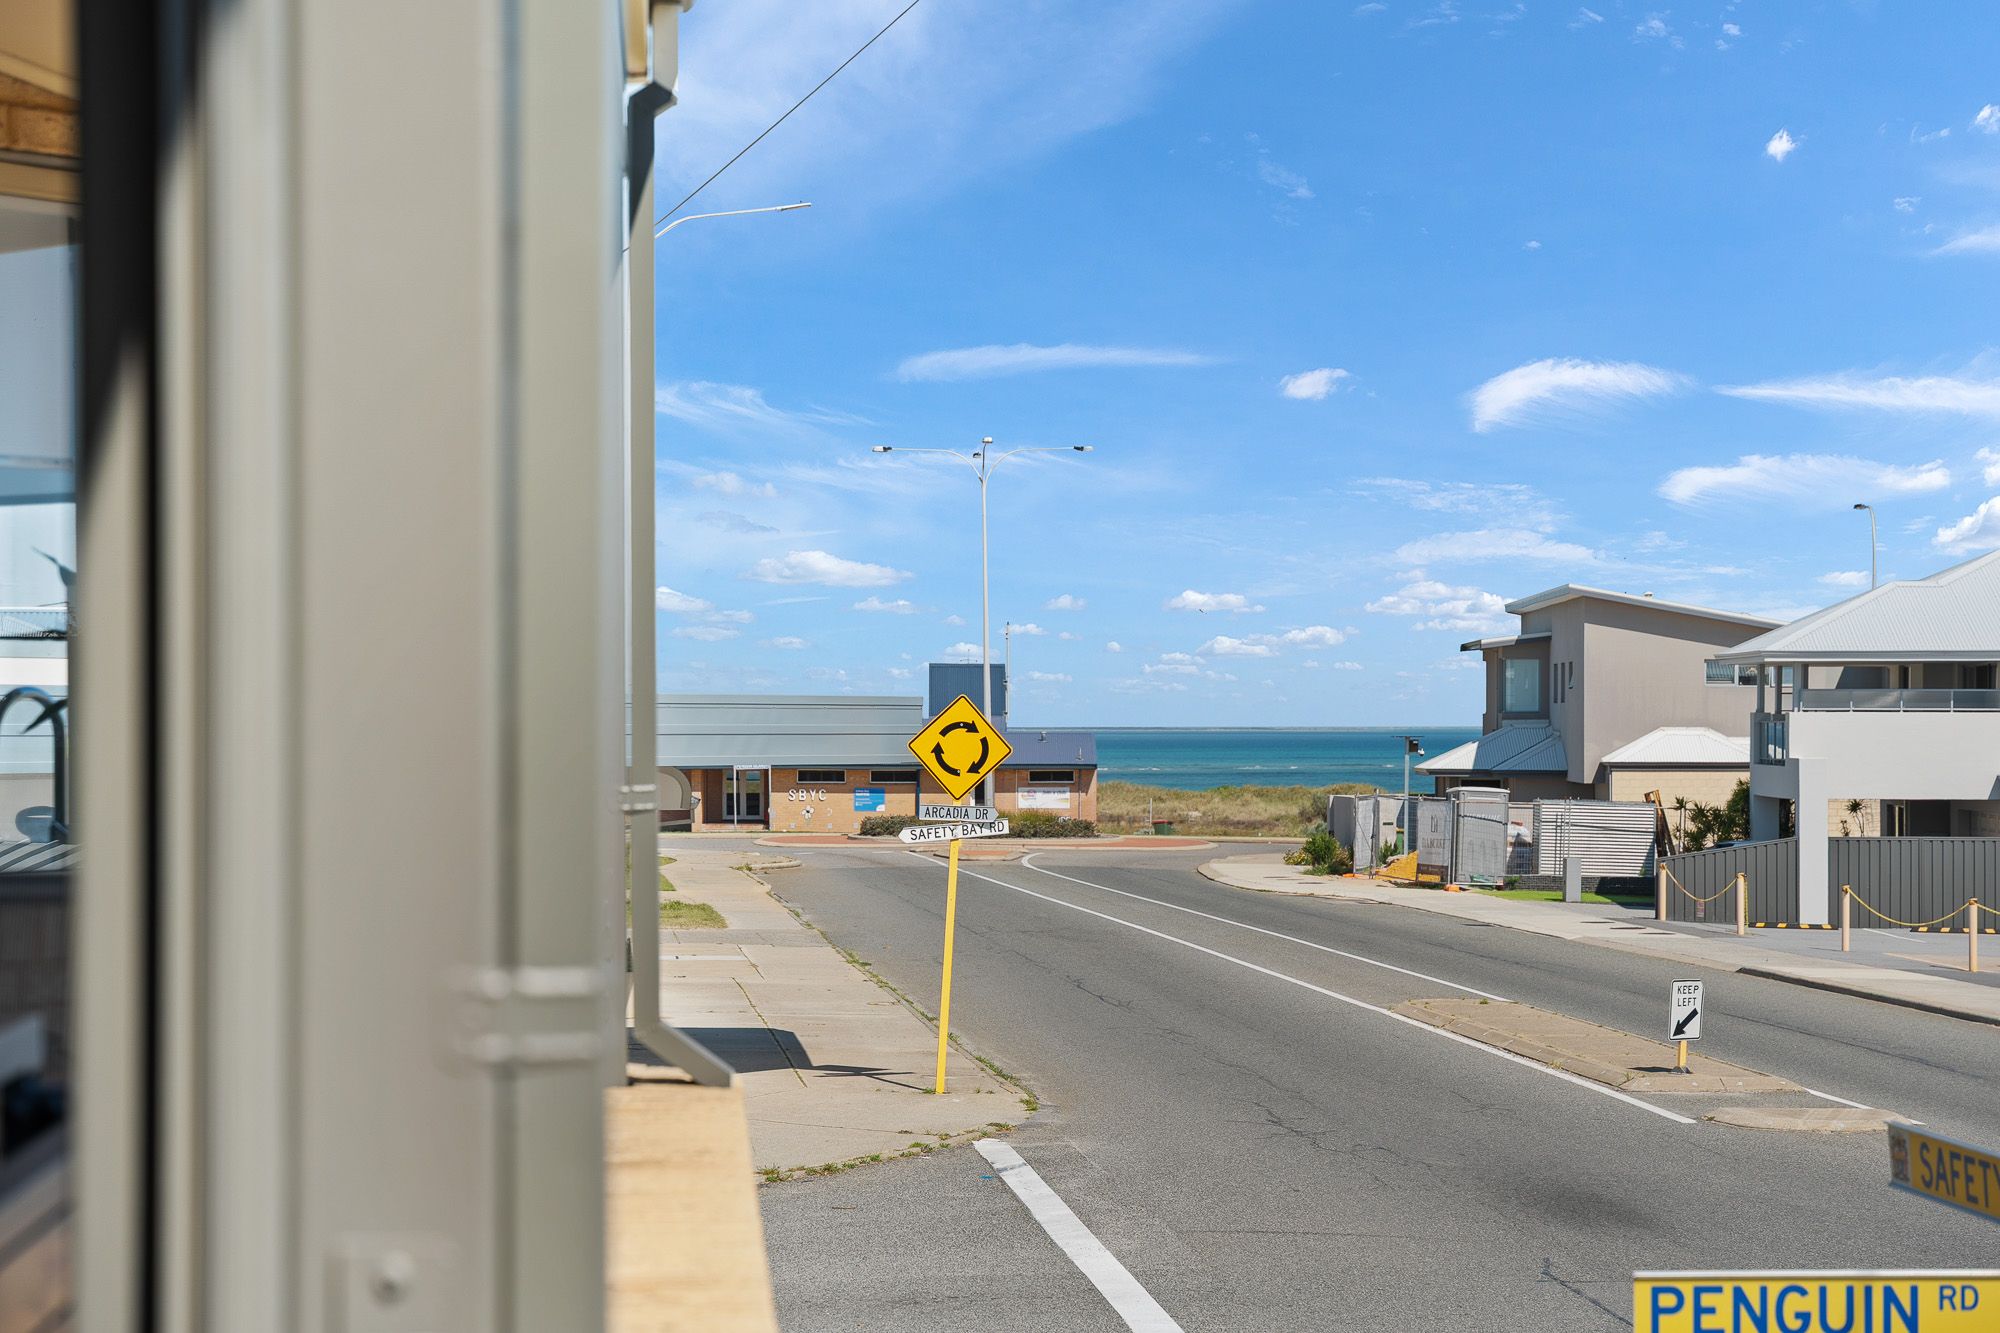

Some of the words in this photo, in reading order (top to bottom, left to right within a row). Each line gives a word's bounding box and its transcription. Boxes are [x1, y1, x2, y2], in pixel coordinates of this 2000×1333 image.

[788, 789, 827, 801] SBYC
[924, 806, 969, 819] ARCADIA
[975, 809, 988, 819] DR
[910, 826, 955, 840] SAFETY
[961, 823, 984, 835] BAY
[990, 821, 1004, 832] RD
[1677, 985, 1699, 994] KEEP
[1677, 998, 1696, 1006] LEFT
[1651, 1285, 1919, 1333] PENGUIN
[1939, 1285, 1979, 1311] RD
